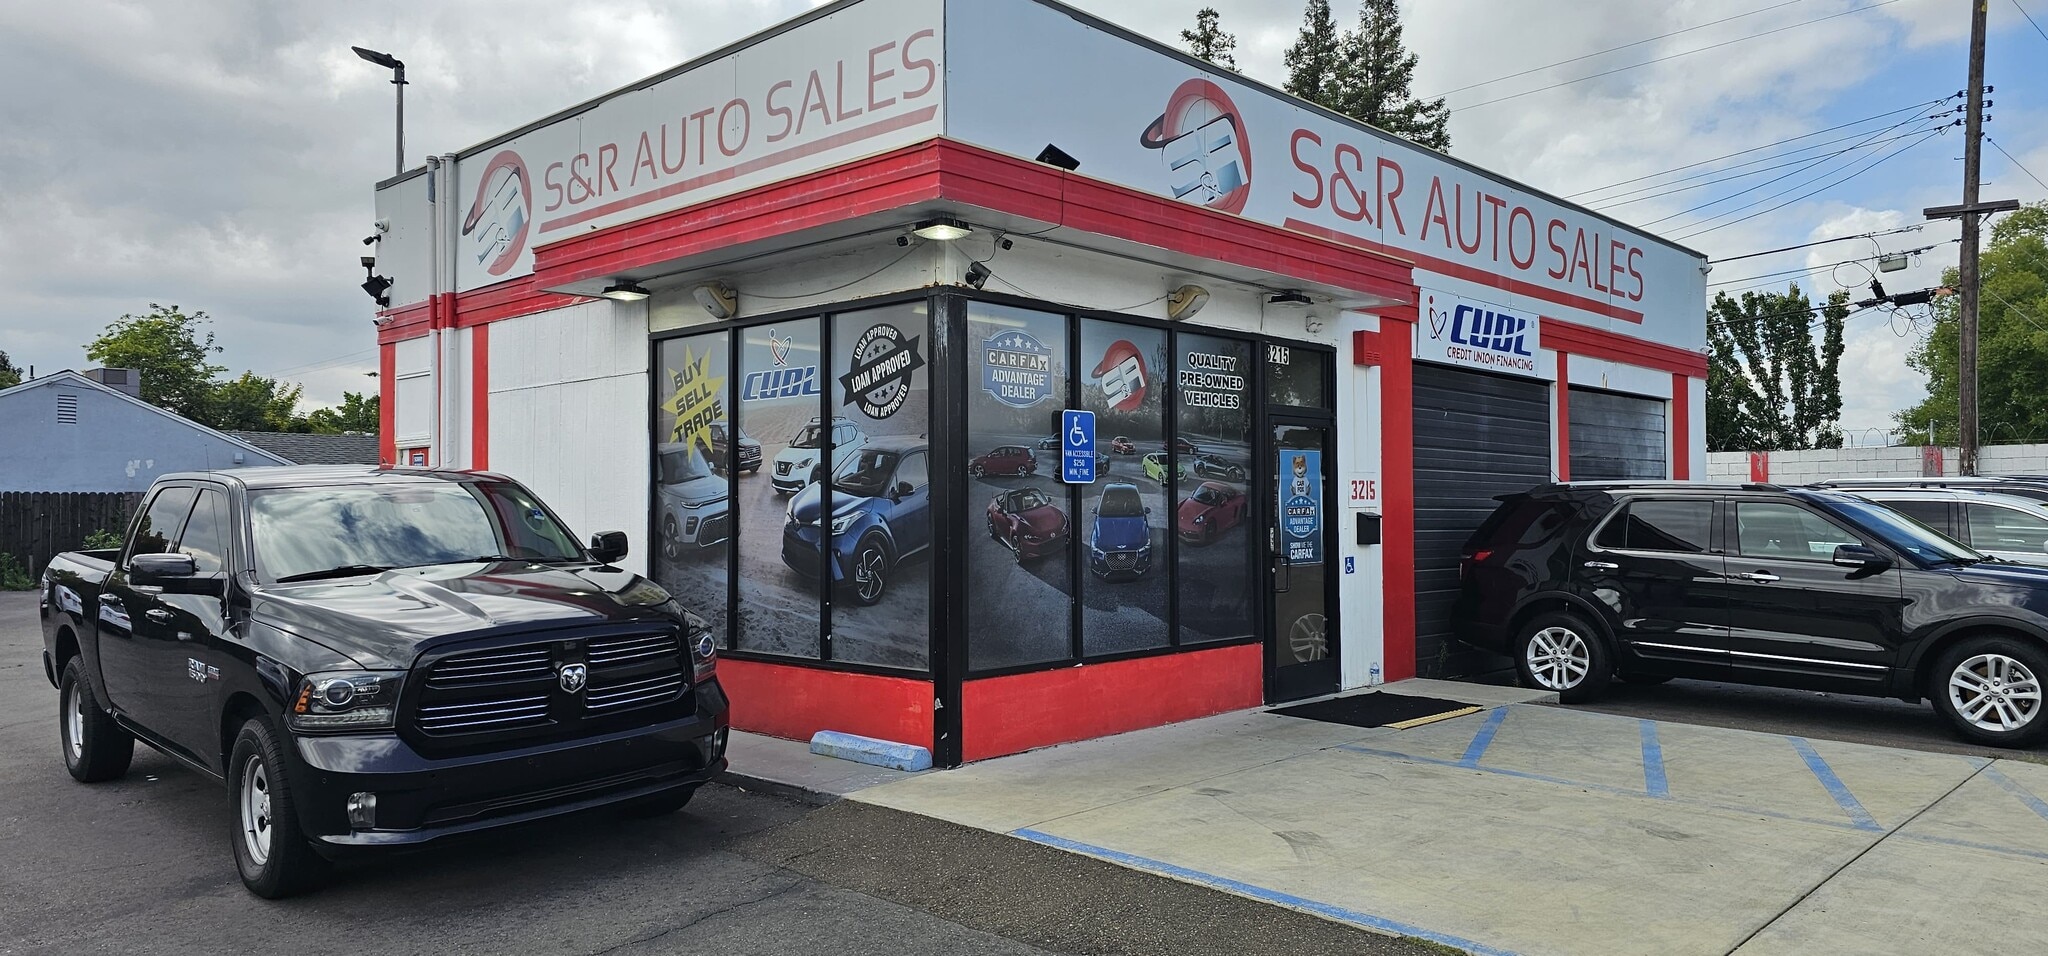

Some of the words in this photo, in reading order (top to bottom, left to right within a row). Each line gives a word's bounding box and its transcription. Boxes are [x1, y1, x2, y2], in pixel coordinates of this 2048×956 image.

[544, 142, 619, 212] S&R
[630, 98, 750, 187] AUTO
[766, 29, 936, 143] SALES
[1290, 128, 1406, 236] S&R
[1420, 175, 1536, 270] AUTO
[1547, 219, 1644, 302] SALES
[1450, 304, 1532, 357] CUDL
[854, 337, 868, 360] LOAN
[866, 326, 898, 341] APPROVED
[988, 351, 1048, 371] CARFAX
[1188, 352, 1236, 371] QUALITY
[1447, 346, 1472, 361] CREDIT
[1473, 350, 1495, 365] UNION
[1497, 356, 1533, 371] FINANCING
[673, 357, 703, 391] BUY
[851, 370, 871, 393] LOAN
[871, 349, 911, 383] APPROVED
[992, 370, 1045, 386] ADVANTAGE
[1180, 370, 1244, 390] PRE-OWNED
[742, 365, 821, 402] CUDL
[1001, 384, 1036, 400] DEALER
[675, 382, 712, 416] SELL
[863, 402, 879, 417] LOAN
[880, 384, 908, 417] APPROVED
[1184, 391, 1239, 409] VEHICLES
[674, 399, 723, 443] TRADE
[1073, 450, 1094, 458] ACCESSIBLE
[1073, 459, 1085, 467] $250
[1080, 468, 1090, 476] FINE
[1351, 480, 1376, 500] 3215
[1287, 507, 1316, 516] CARFAX
[1289, 517, 1314, 525] ADVANTAGE
[1293, 525, 1310, 533] DEALER
[1290, 548, 1314, 560] CARFAX
